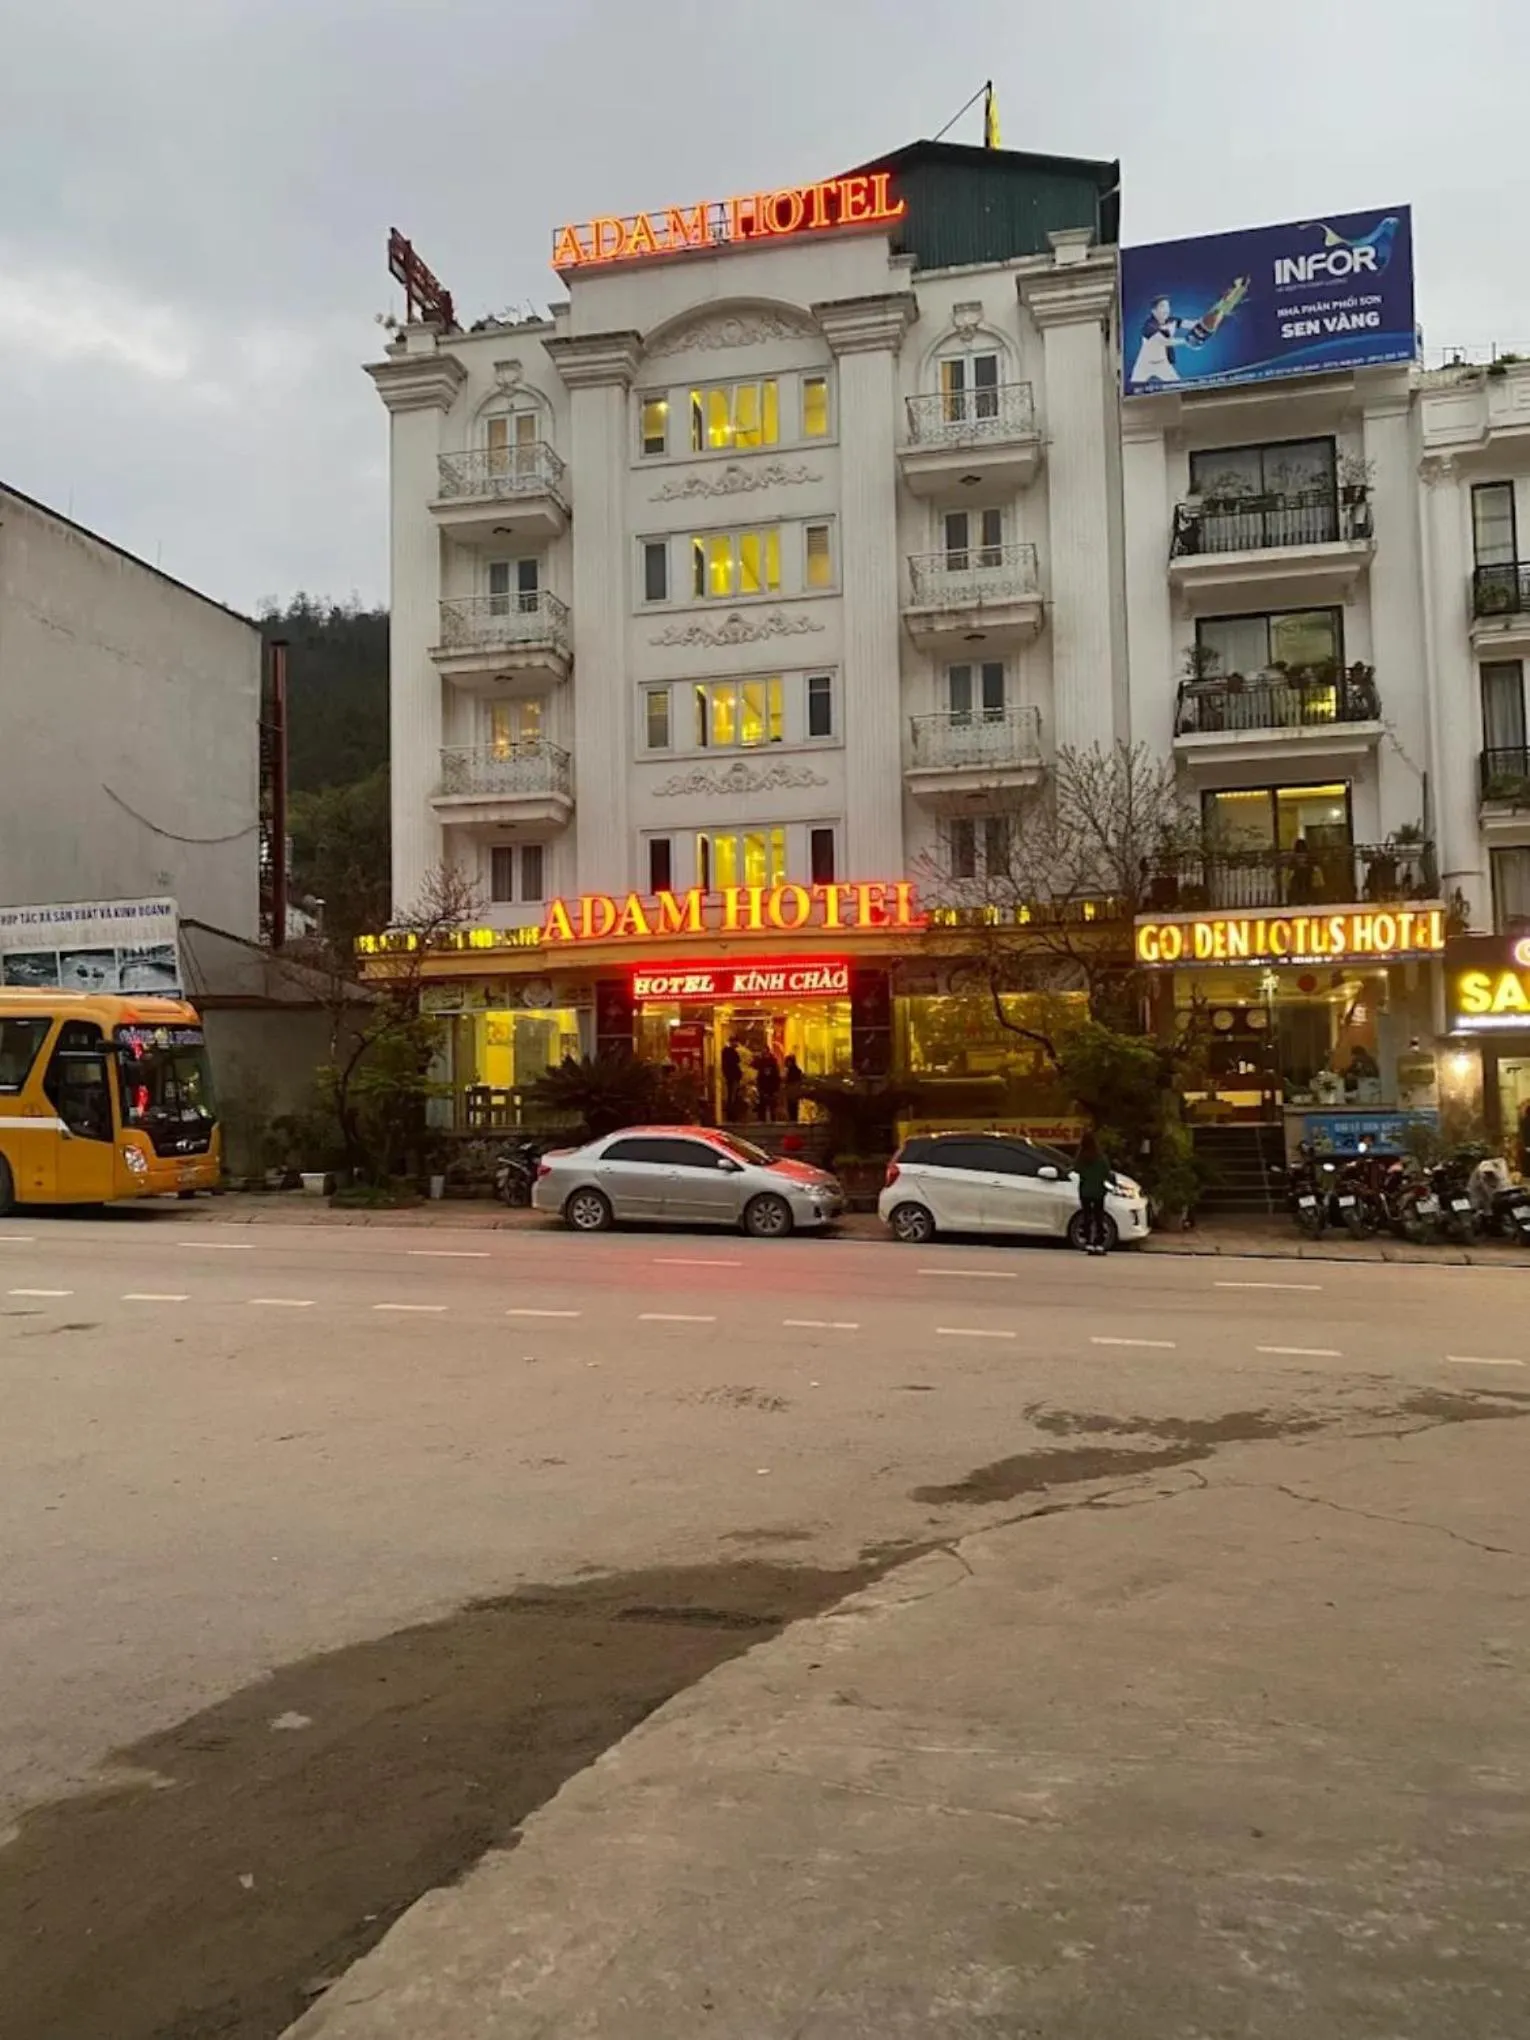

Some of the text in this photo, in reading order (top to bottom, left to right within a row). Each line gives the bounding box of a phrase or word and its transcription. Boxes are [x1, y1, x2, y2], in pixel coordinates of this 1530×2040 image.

[553, 172, 905, 265] ADAM HOTEL
[1274, 245, 1378, 285] INFOR
[1281, 311, 1381, 338] SEN VÀNG
[540, 887, 708, 941] ADAM
[720, 880, 929, 931] HOTEL
[1352, 910, 1445, 951] HOTEL
[634, 967, 848, 995] HOTEL KÍNH CHÀO
